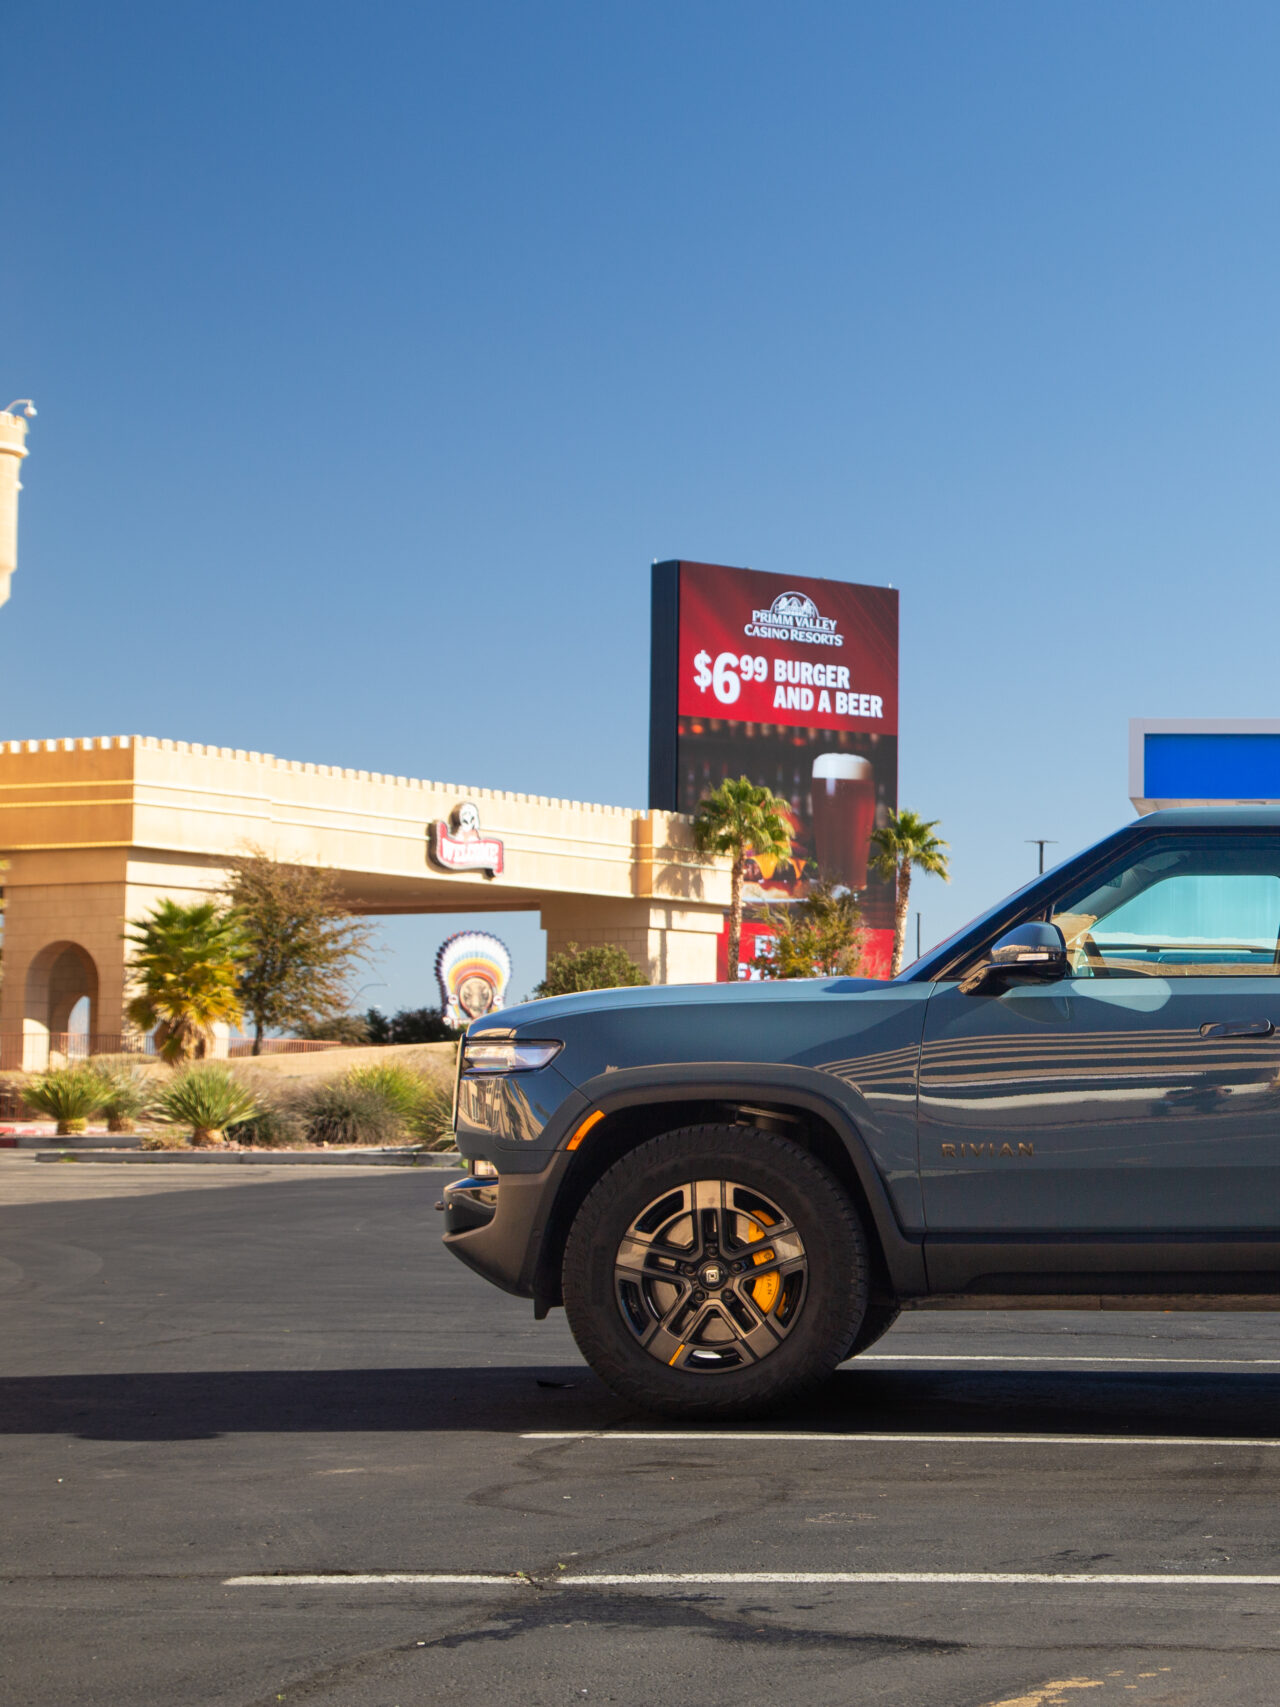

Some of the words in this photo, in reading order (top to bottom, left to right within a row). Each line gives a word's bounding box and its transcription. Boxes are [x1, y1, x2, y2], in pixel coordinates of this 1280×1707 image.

[752, 610, 793, 626] PRIMM
[795, 616, 837, 631] VALLEY
[744, 624, 789, 641] CASINO
[790, 629, 844, 647] RESORTS
[774, 659, 850, 690] BURGER
[773, 685, 814, 711] AND
[818, 690, 832, 713] A
[835, 691, 883, 718] BEER
[941, 1142, 1034, 1158] RIVIAN
